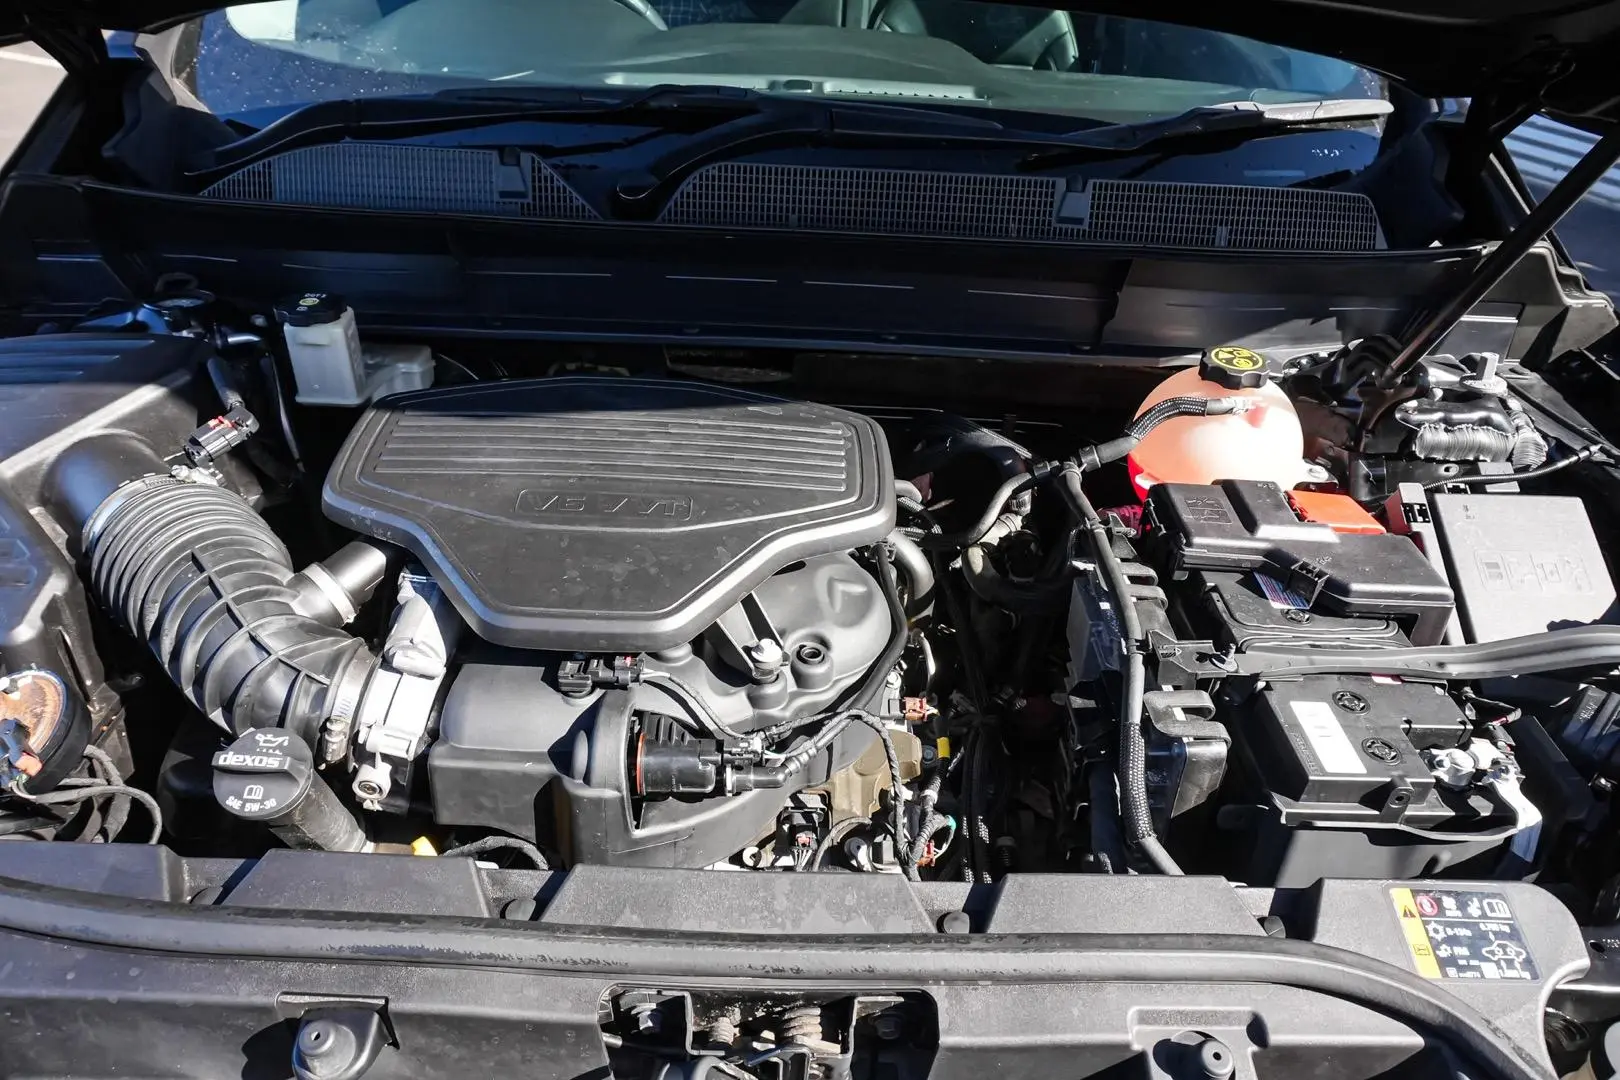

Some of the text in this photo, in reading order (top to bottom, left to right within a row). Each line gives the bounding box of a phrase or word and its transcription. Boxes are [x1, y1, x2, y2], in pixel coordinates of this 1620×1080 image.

[218, 751, 283, 768] dexos
[225, 796, 277, 812] SAE 5W-30
